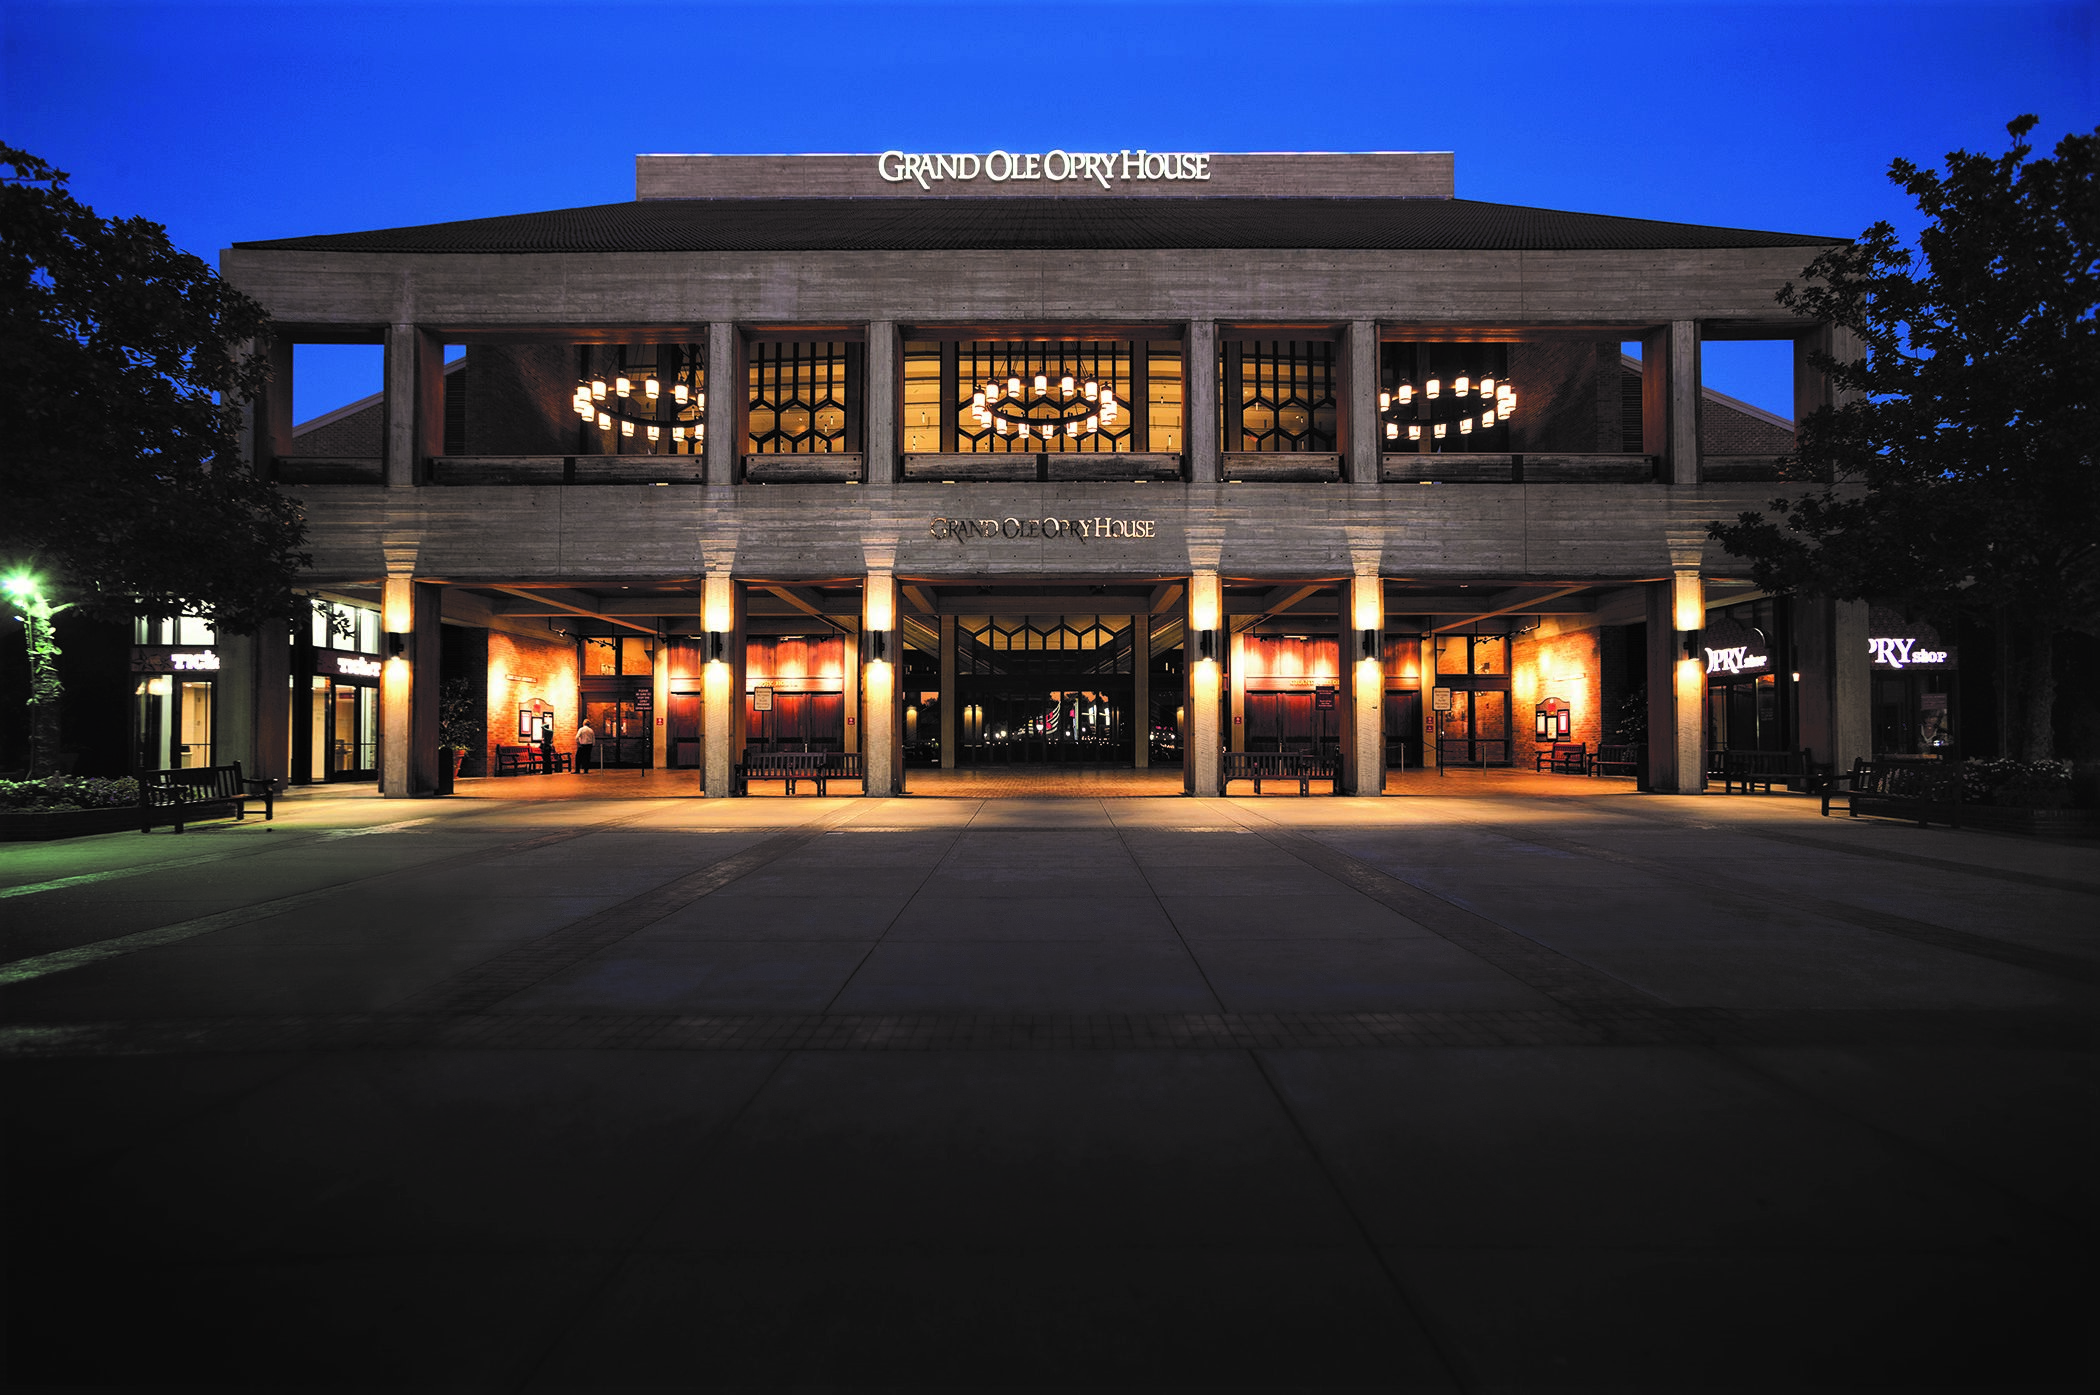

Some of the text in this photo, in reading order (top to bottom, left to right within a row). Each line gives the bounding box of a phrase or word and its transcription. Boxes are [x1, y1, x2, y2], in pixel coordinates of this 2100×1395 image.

[878, 149, 1211, 191] GRAND OLE OPRY HOUSE
[929, 517, 1155, 544] GRAND OLE OPRY HOUSE
